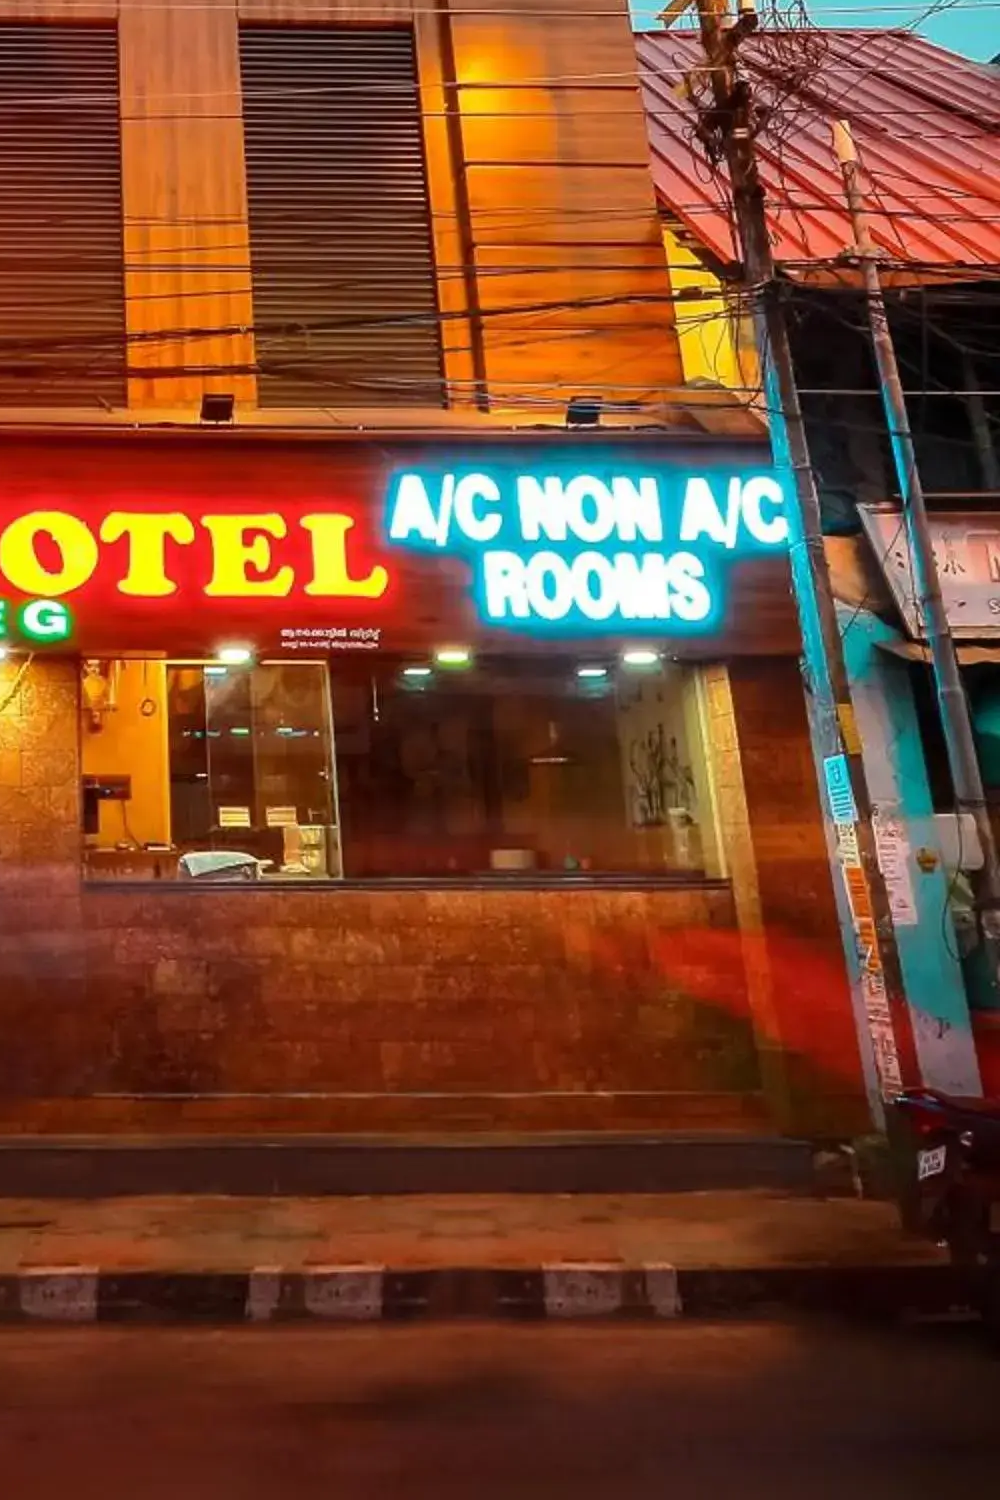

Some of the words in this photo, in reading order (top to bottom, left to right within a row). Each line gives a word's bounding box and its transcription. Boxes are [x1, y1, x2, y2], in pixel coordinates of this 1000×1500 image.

[391, 474, 502, 547] A/C
[516, 476, 662, 541] NON
[679, 476, 789, 548] A/C
[483, 551, 711, 621] ROOMS
